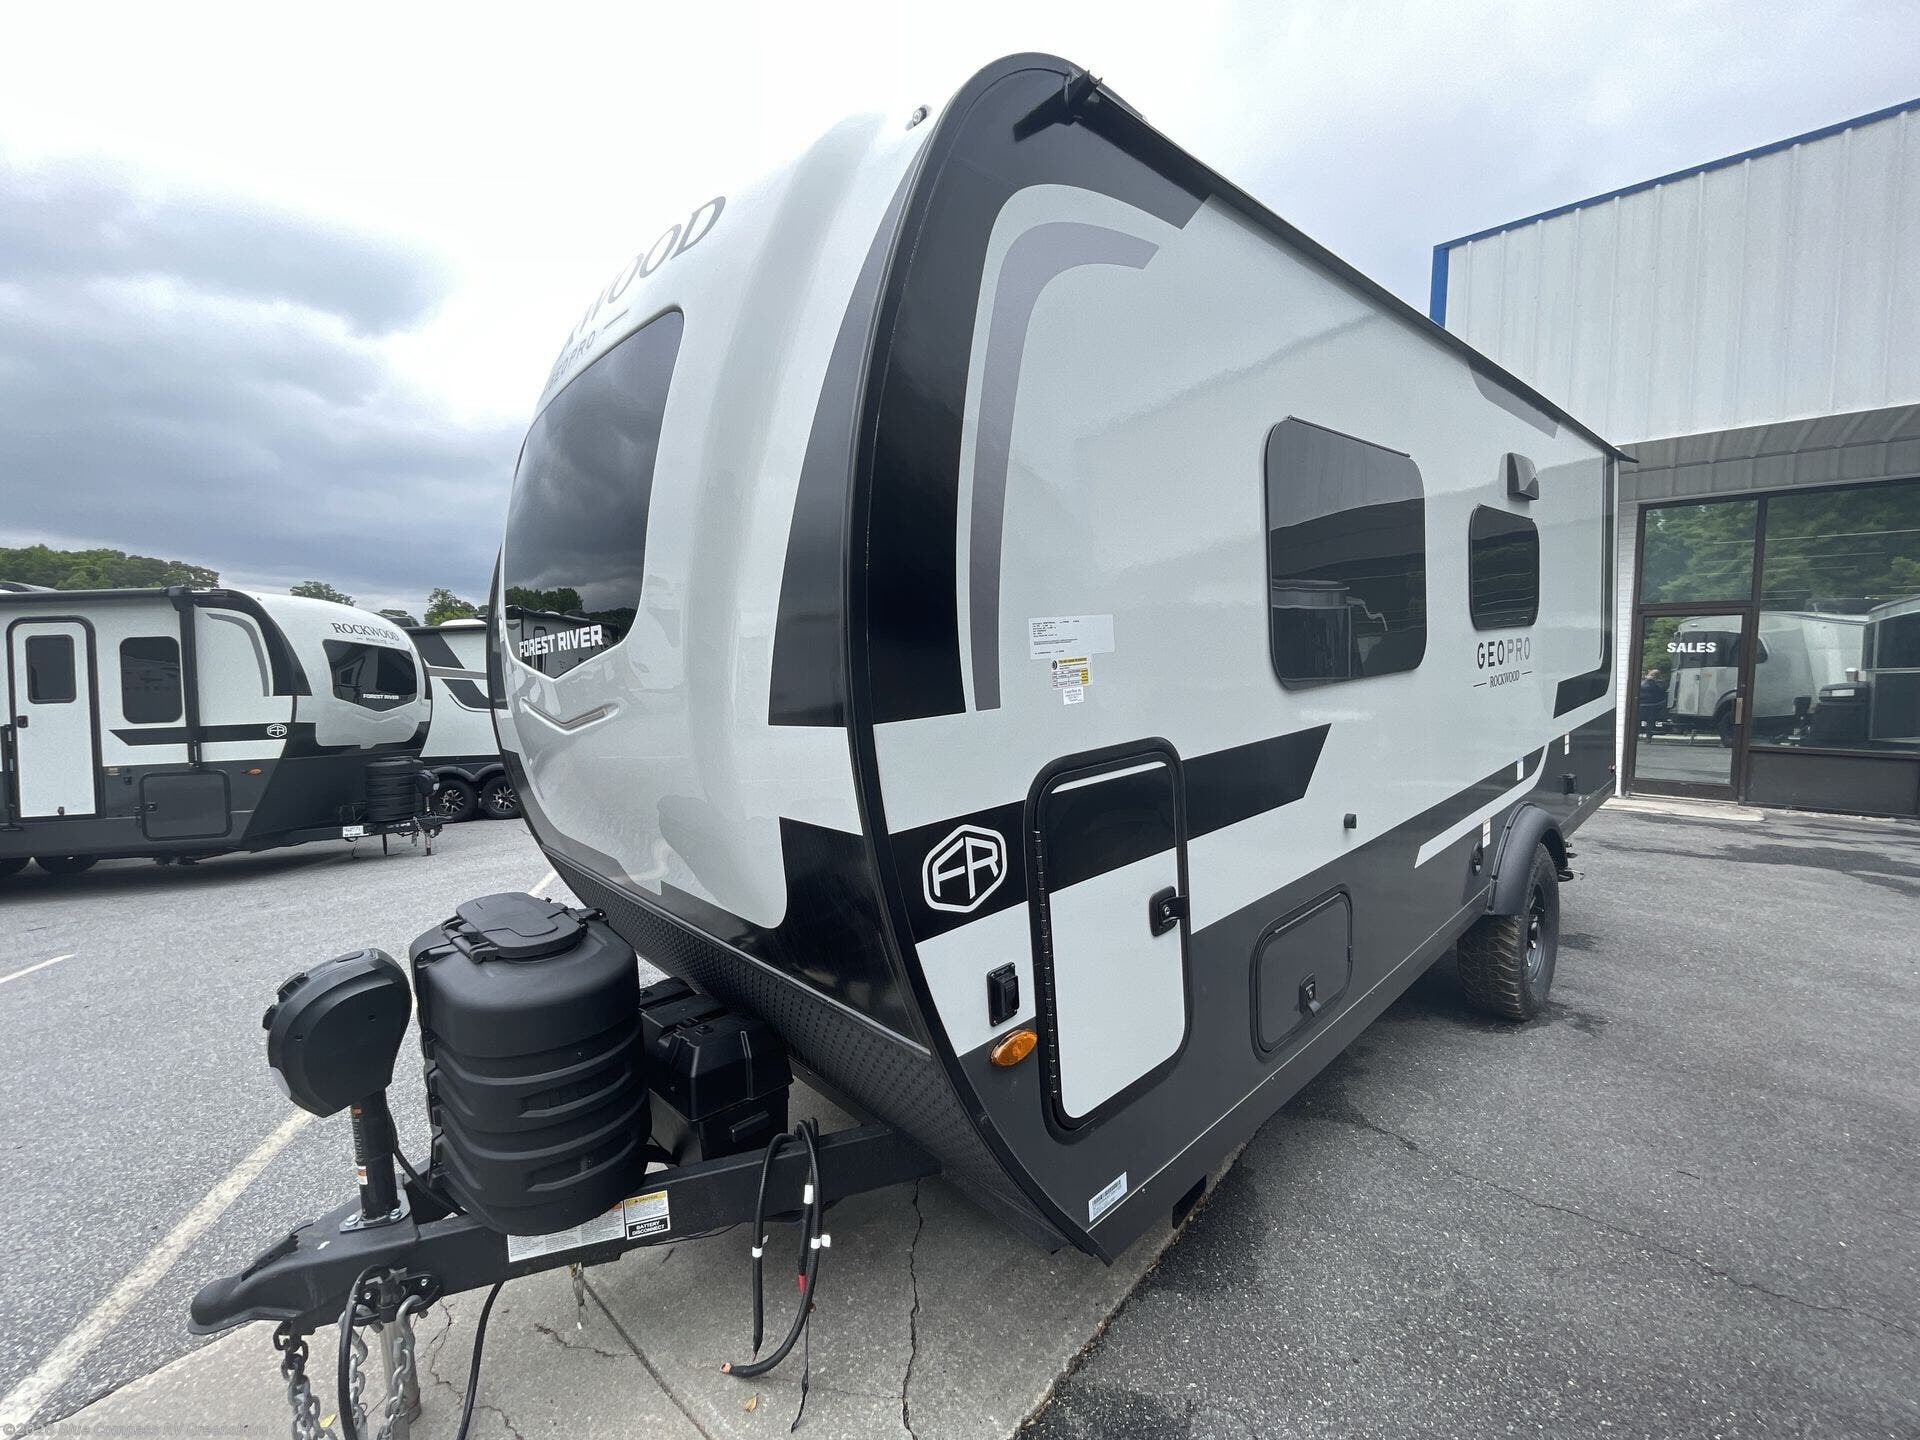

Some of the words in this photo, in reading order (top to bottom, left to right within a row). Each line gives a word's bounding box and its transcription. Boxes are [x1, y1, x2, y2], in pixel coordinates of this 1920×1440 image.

[332, 623, 400, 642] ROCKWOOD
[518, 634, 556, 658] FOREST
[557, 624, 604, 652] RIVER
[1666, 641, 1717, 653] SALES
[1490, 670, 1520, 688] ROCKWOOD
[632, 1223, 665, 1236] DISCONNECT
[636, 1220, 661, 1230] BATTERY
